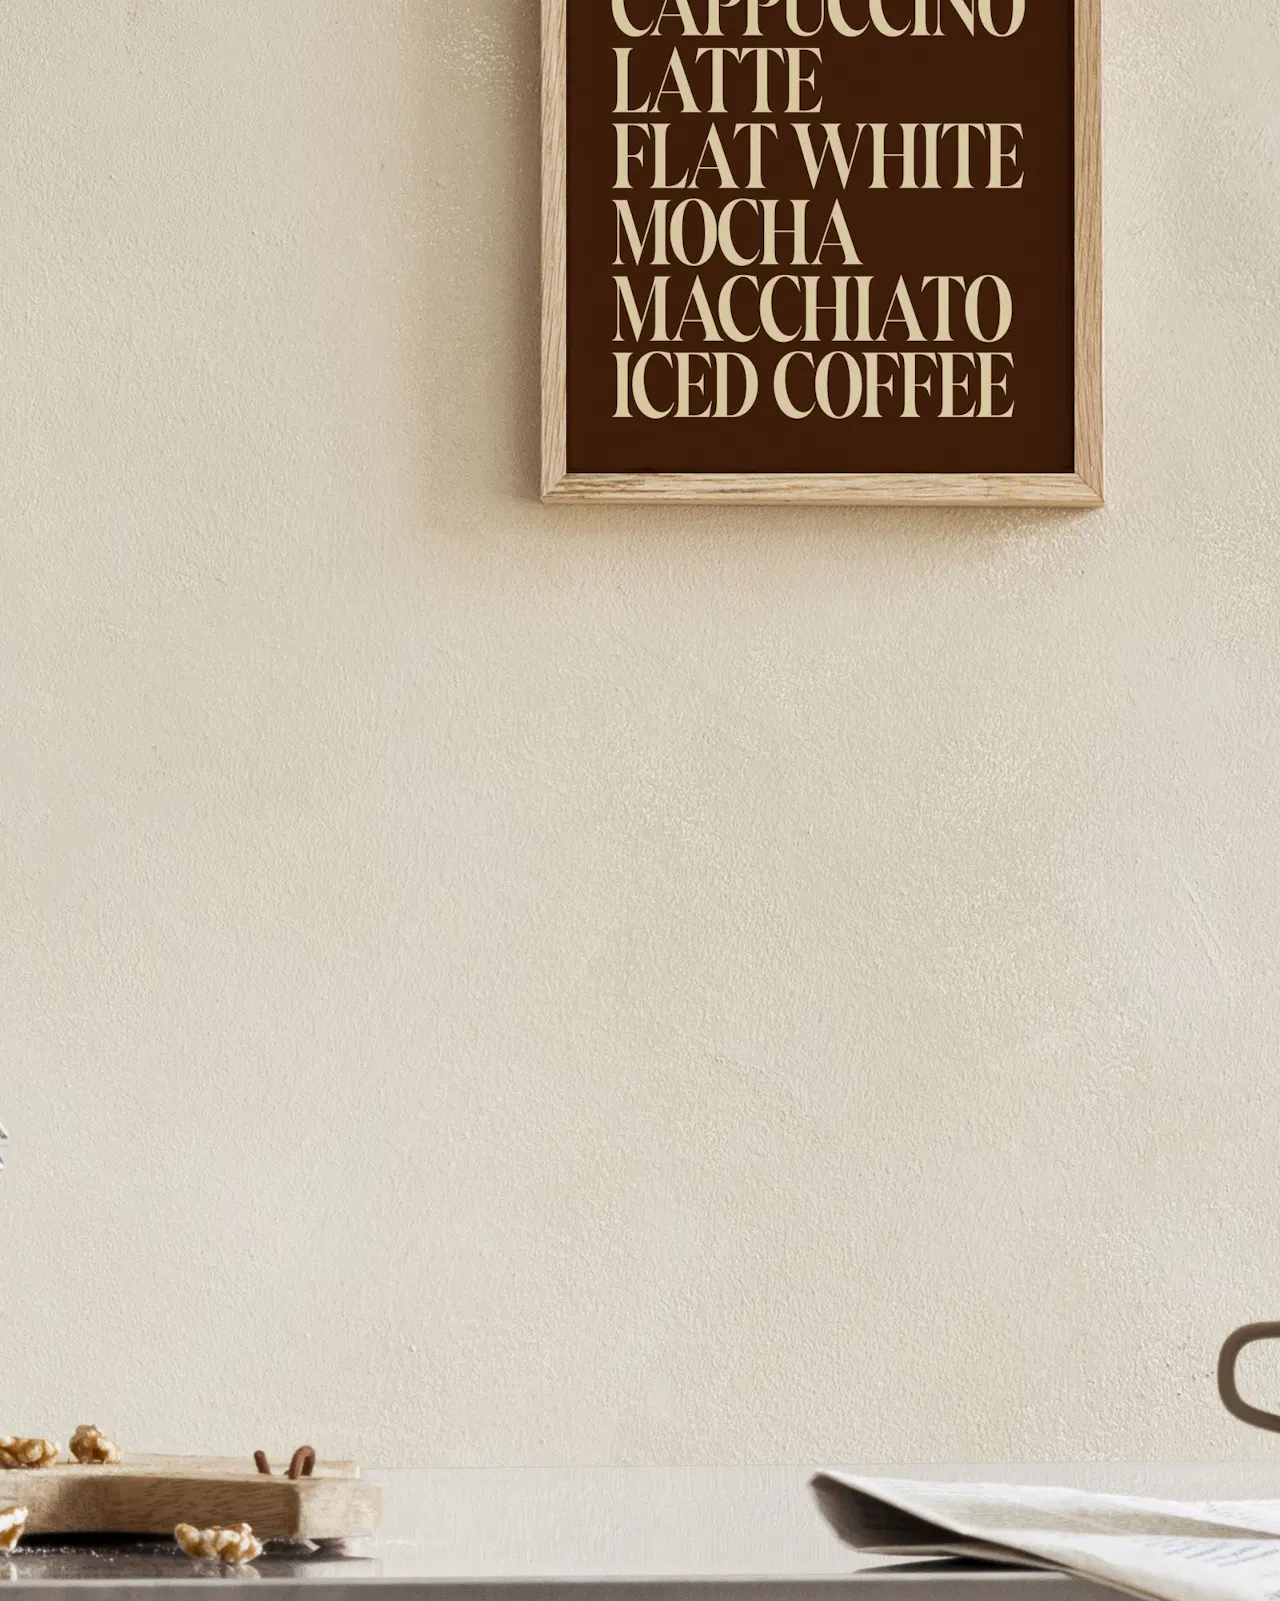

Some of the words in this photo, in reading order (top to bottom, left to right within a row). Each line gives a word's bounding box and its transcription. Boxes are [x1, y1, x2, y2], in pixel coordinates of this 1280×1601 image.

[611, 46, 823, 113] LATTE
[611, 121, 779, 190] FLAT
[790, 121, 1025, 190] WHITE
[611, 197, 864, 267] MOCHA
[611, 274, 1013, 343] MACCHIATO
[611, 350, 759, 420] ICED
[773, 350, 1015, 420] COFFEE
